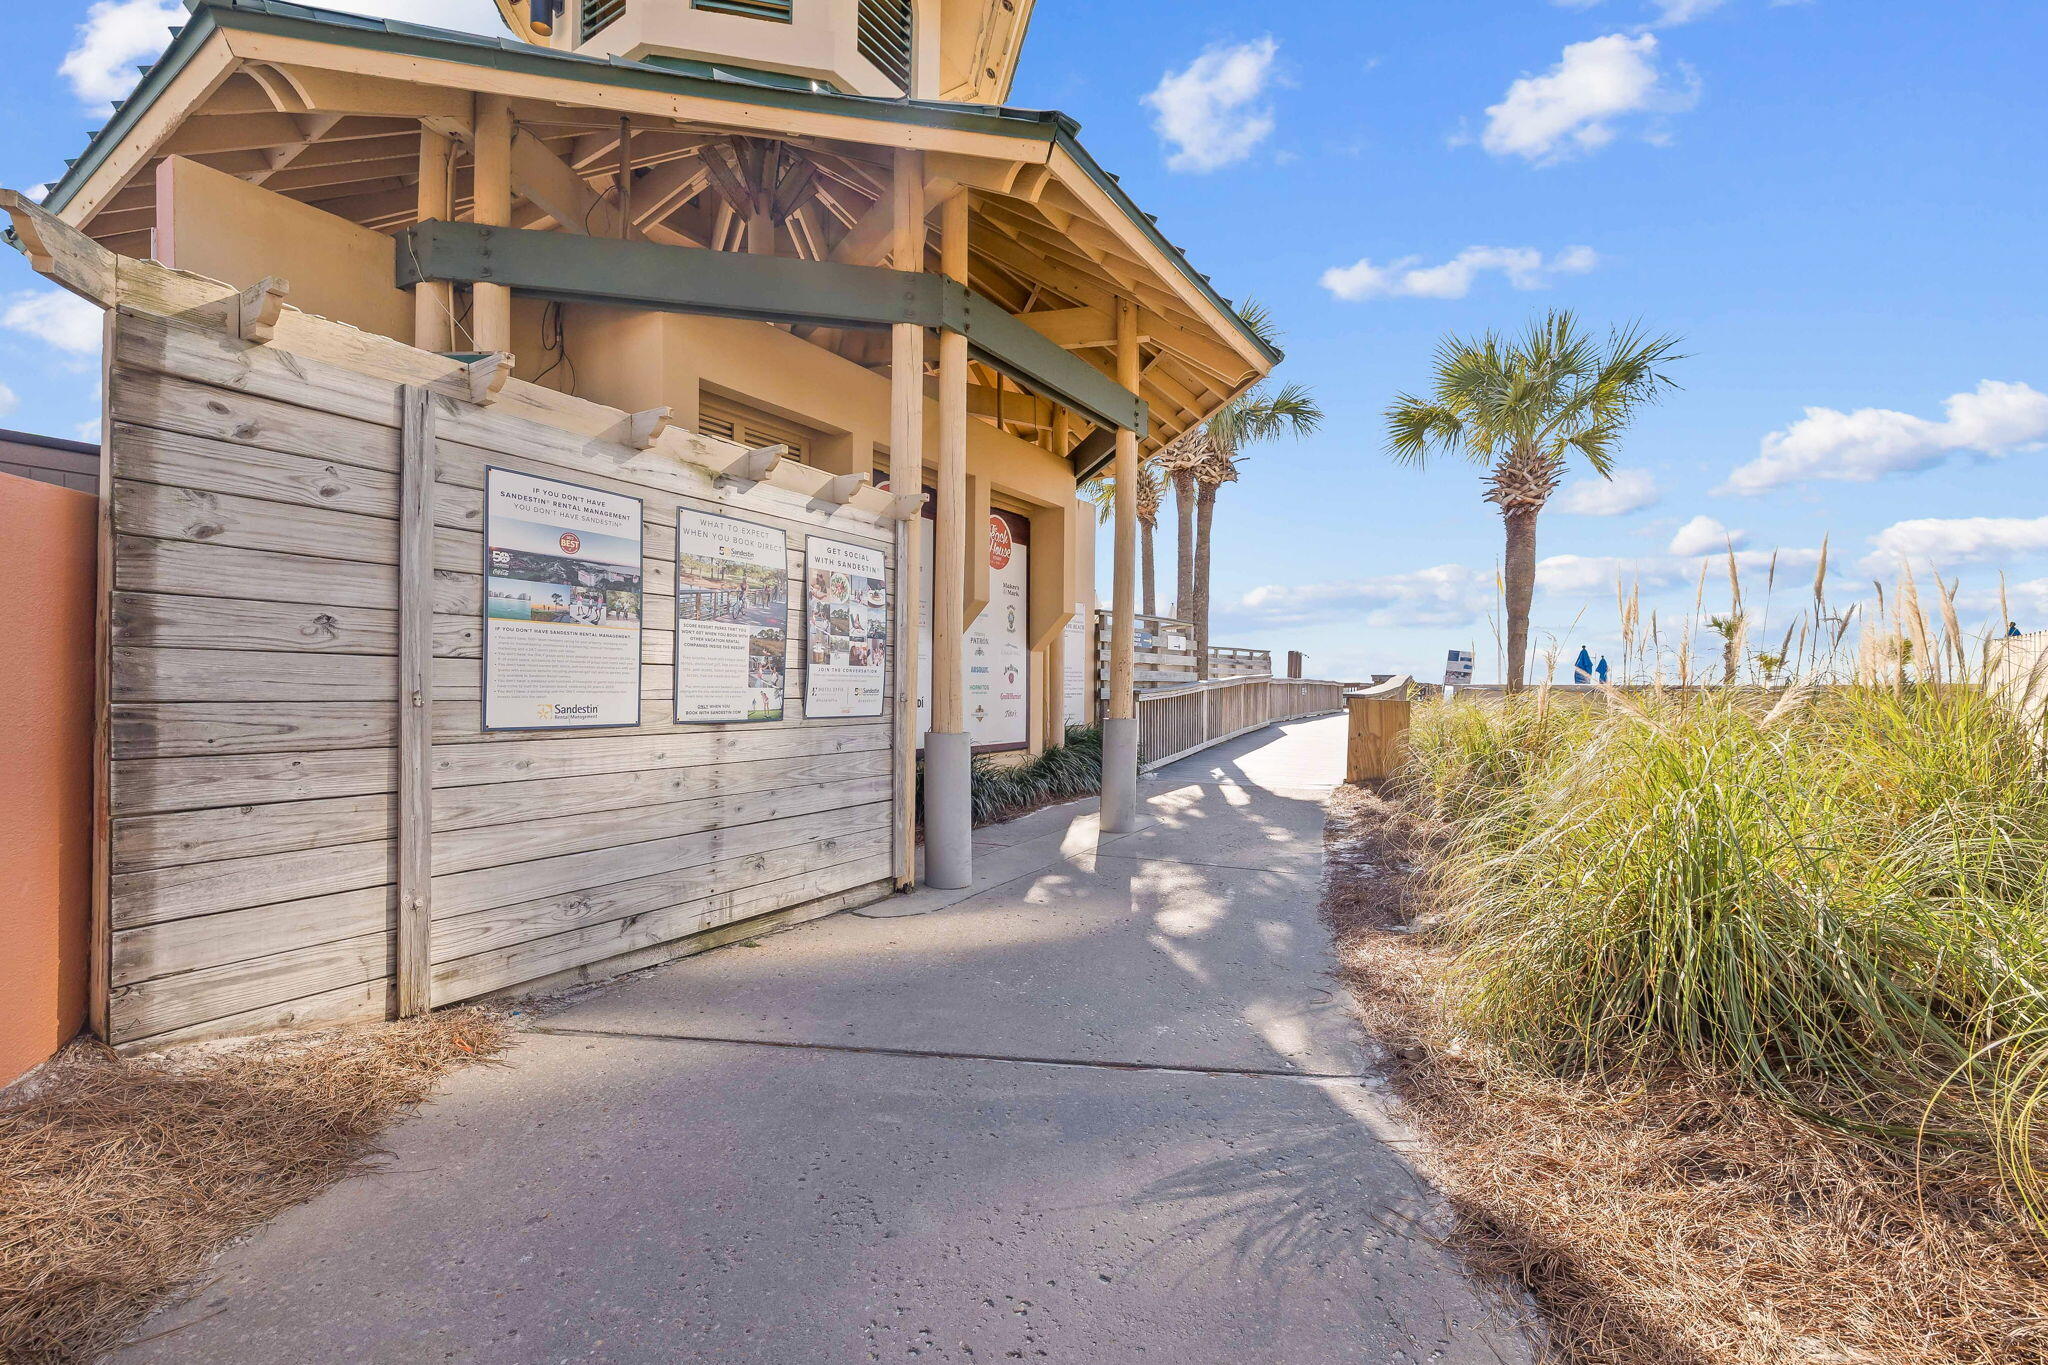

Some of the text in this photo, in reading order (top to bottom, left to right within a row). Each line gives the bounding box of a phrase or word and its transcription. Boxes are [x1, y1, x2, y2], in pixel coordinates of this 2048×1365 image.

[543, 490, 559, 498] YOU
[562, 494, 584, 503] DON'T
[586, 498, 606, 508] HAVE
[514, 502, 531, 512] YOU
[534, 506, 557, 516] DON'T
[560, 512, 580, 521] HAVE
[552, 501, 581, 512] RENTAL
[583, 507, 630, 521] MANAGEMENT
[700, 519, 769, 538] WHAT TO EXPECT
[560, 538, 579, 548] BEST
[682, 528, 782, 552] WHEN YOU BOOK DIRECT
[814, 556, 834, 565] WITH
[844, 550, 869, 561] SOCIAL
[555, 704, 598, 714] Sandestin
